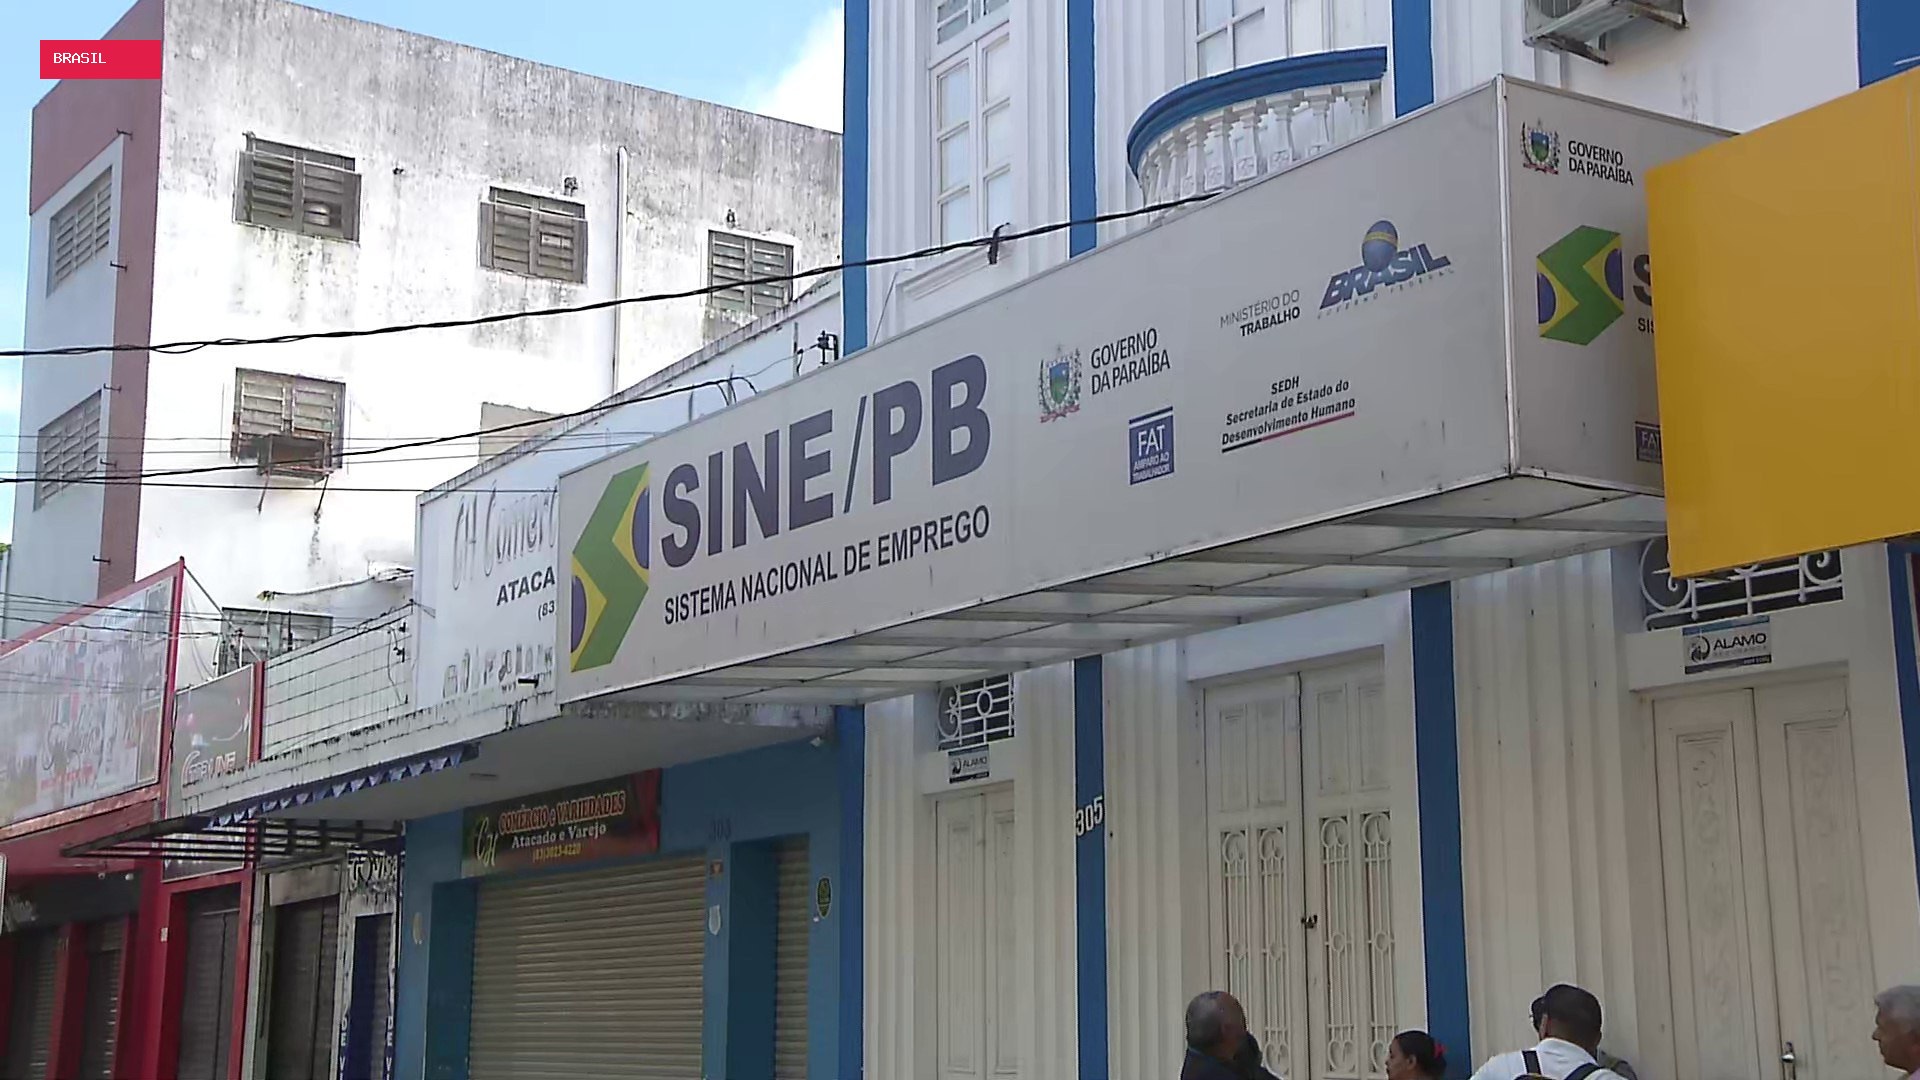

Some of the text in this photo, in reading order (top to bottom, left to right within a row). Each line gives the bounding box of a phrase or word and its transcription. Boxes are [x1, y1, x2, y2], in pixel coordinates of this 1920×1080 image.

[1568, 140, 1624, 166] GOVERNO
[1568, 157, 1634, 186] DA PARAÍBA
[1319, 243, 1451, 310] BRASIL
[1220, 289, 1300, 328] MINISTÉRIO DO
[1240, 306, 1301, 337] TRABALHO
[1091, 327, 1158, 369] GOVERNO
[1091, 349, 1171, 395] DA PARAÍBA
[1271, 376, 1300, 396] SEDH
[1221, 398, 1356, 446] Desenvolvimento Humano
[1226, 380, 1349, 426] Secretaria de Estado do
[661, 354, 991, 568] SINE/PB
[1138, 424, 1165, 457] FAT
[664, 504, 990, 625] SISTEMA NACIONAL DE EMPREGO
[1713, 632, 1767, 651] ALAMO
[498, 804, 549, 835] COMÉRCIO
[556, 790, 626, 825] VARIEDADES
[1075, 795, 1103, 836] 305
[511, 822, 607, 849] Atacado e Varejo
